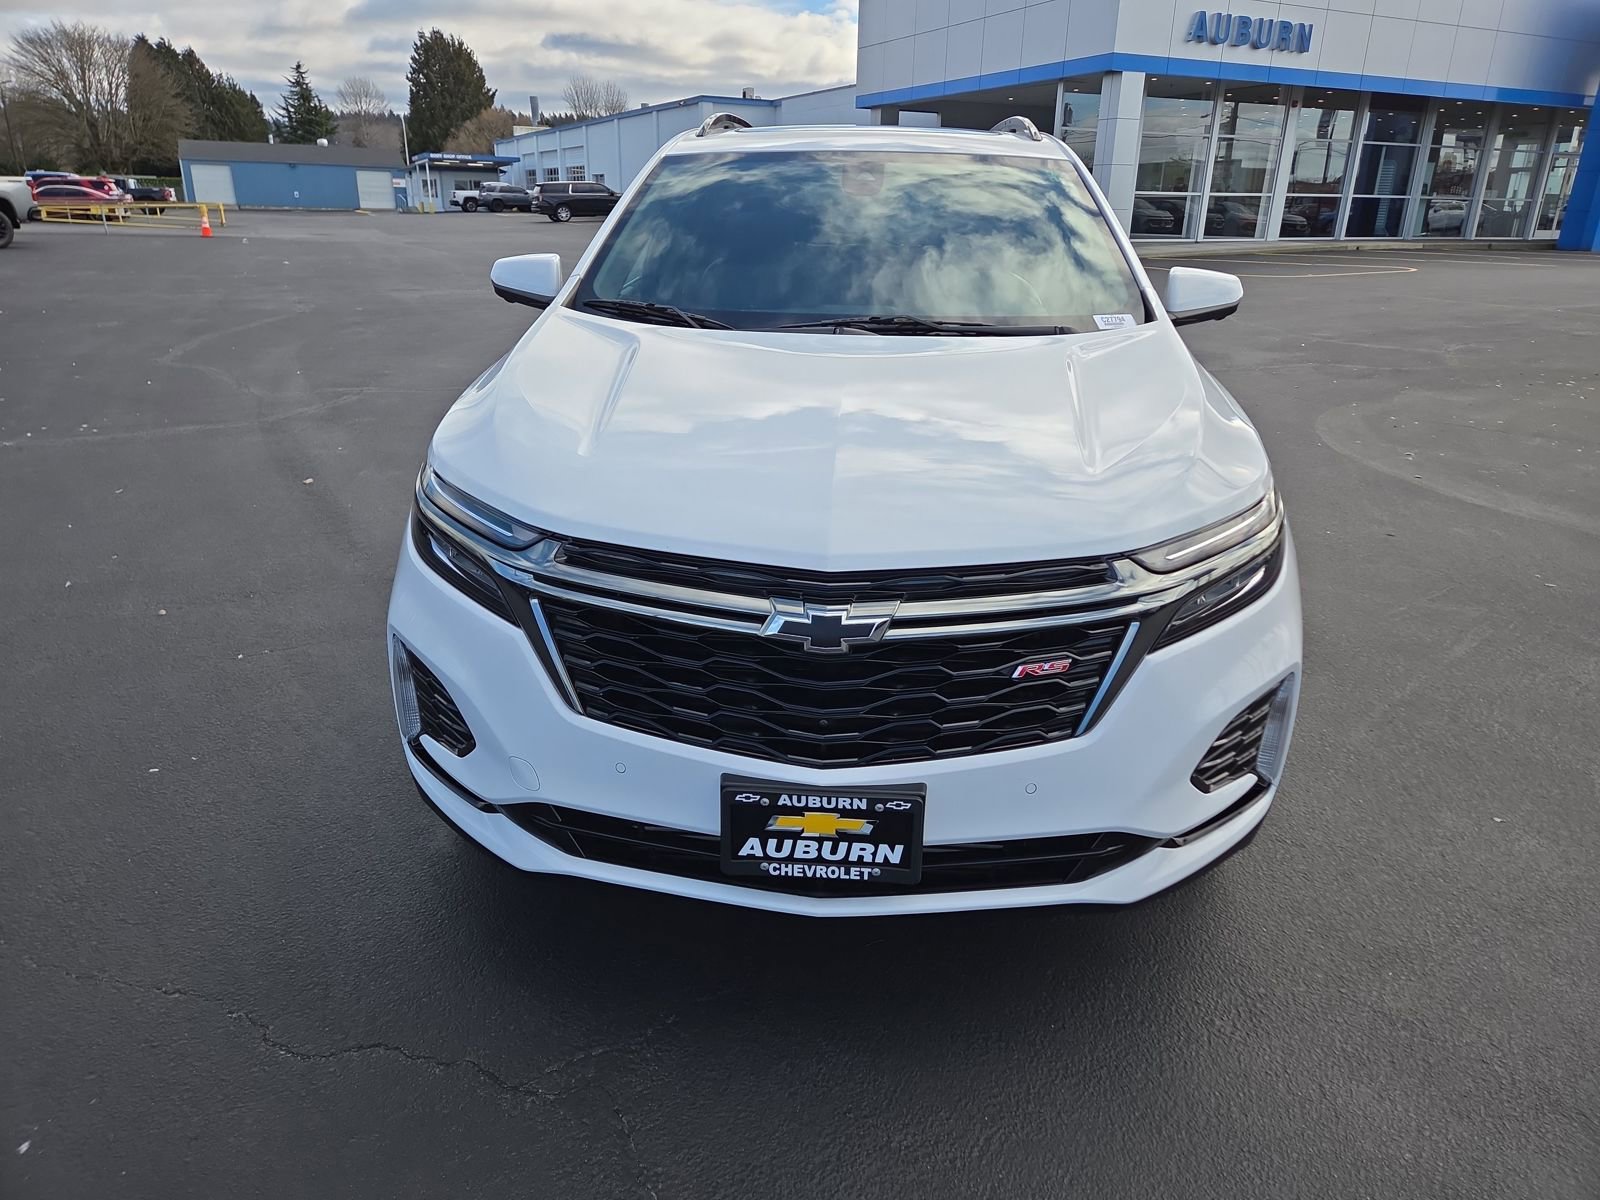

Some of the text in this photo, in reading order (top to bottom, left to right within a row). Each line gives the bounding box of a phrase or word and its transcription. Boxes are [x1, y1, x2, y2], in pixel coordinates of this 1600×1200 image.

[1186, 10, 1313, 53] AUBURN
[1012, 659, 1072, 678] RS
[777, 794, 867, 810] AUBURN
[738, 837, 904, 864] AUBURN
[768, 863, 872, 881] CHEVROLET
